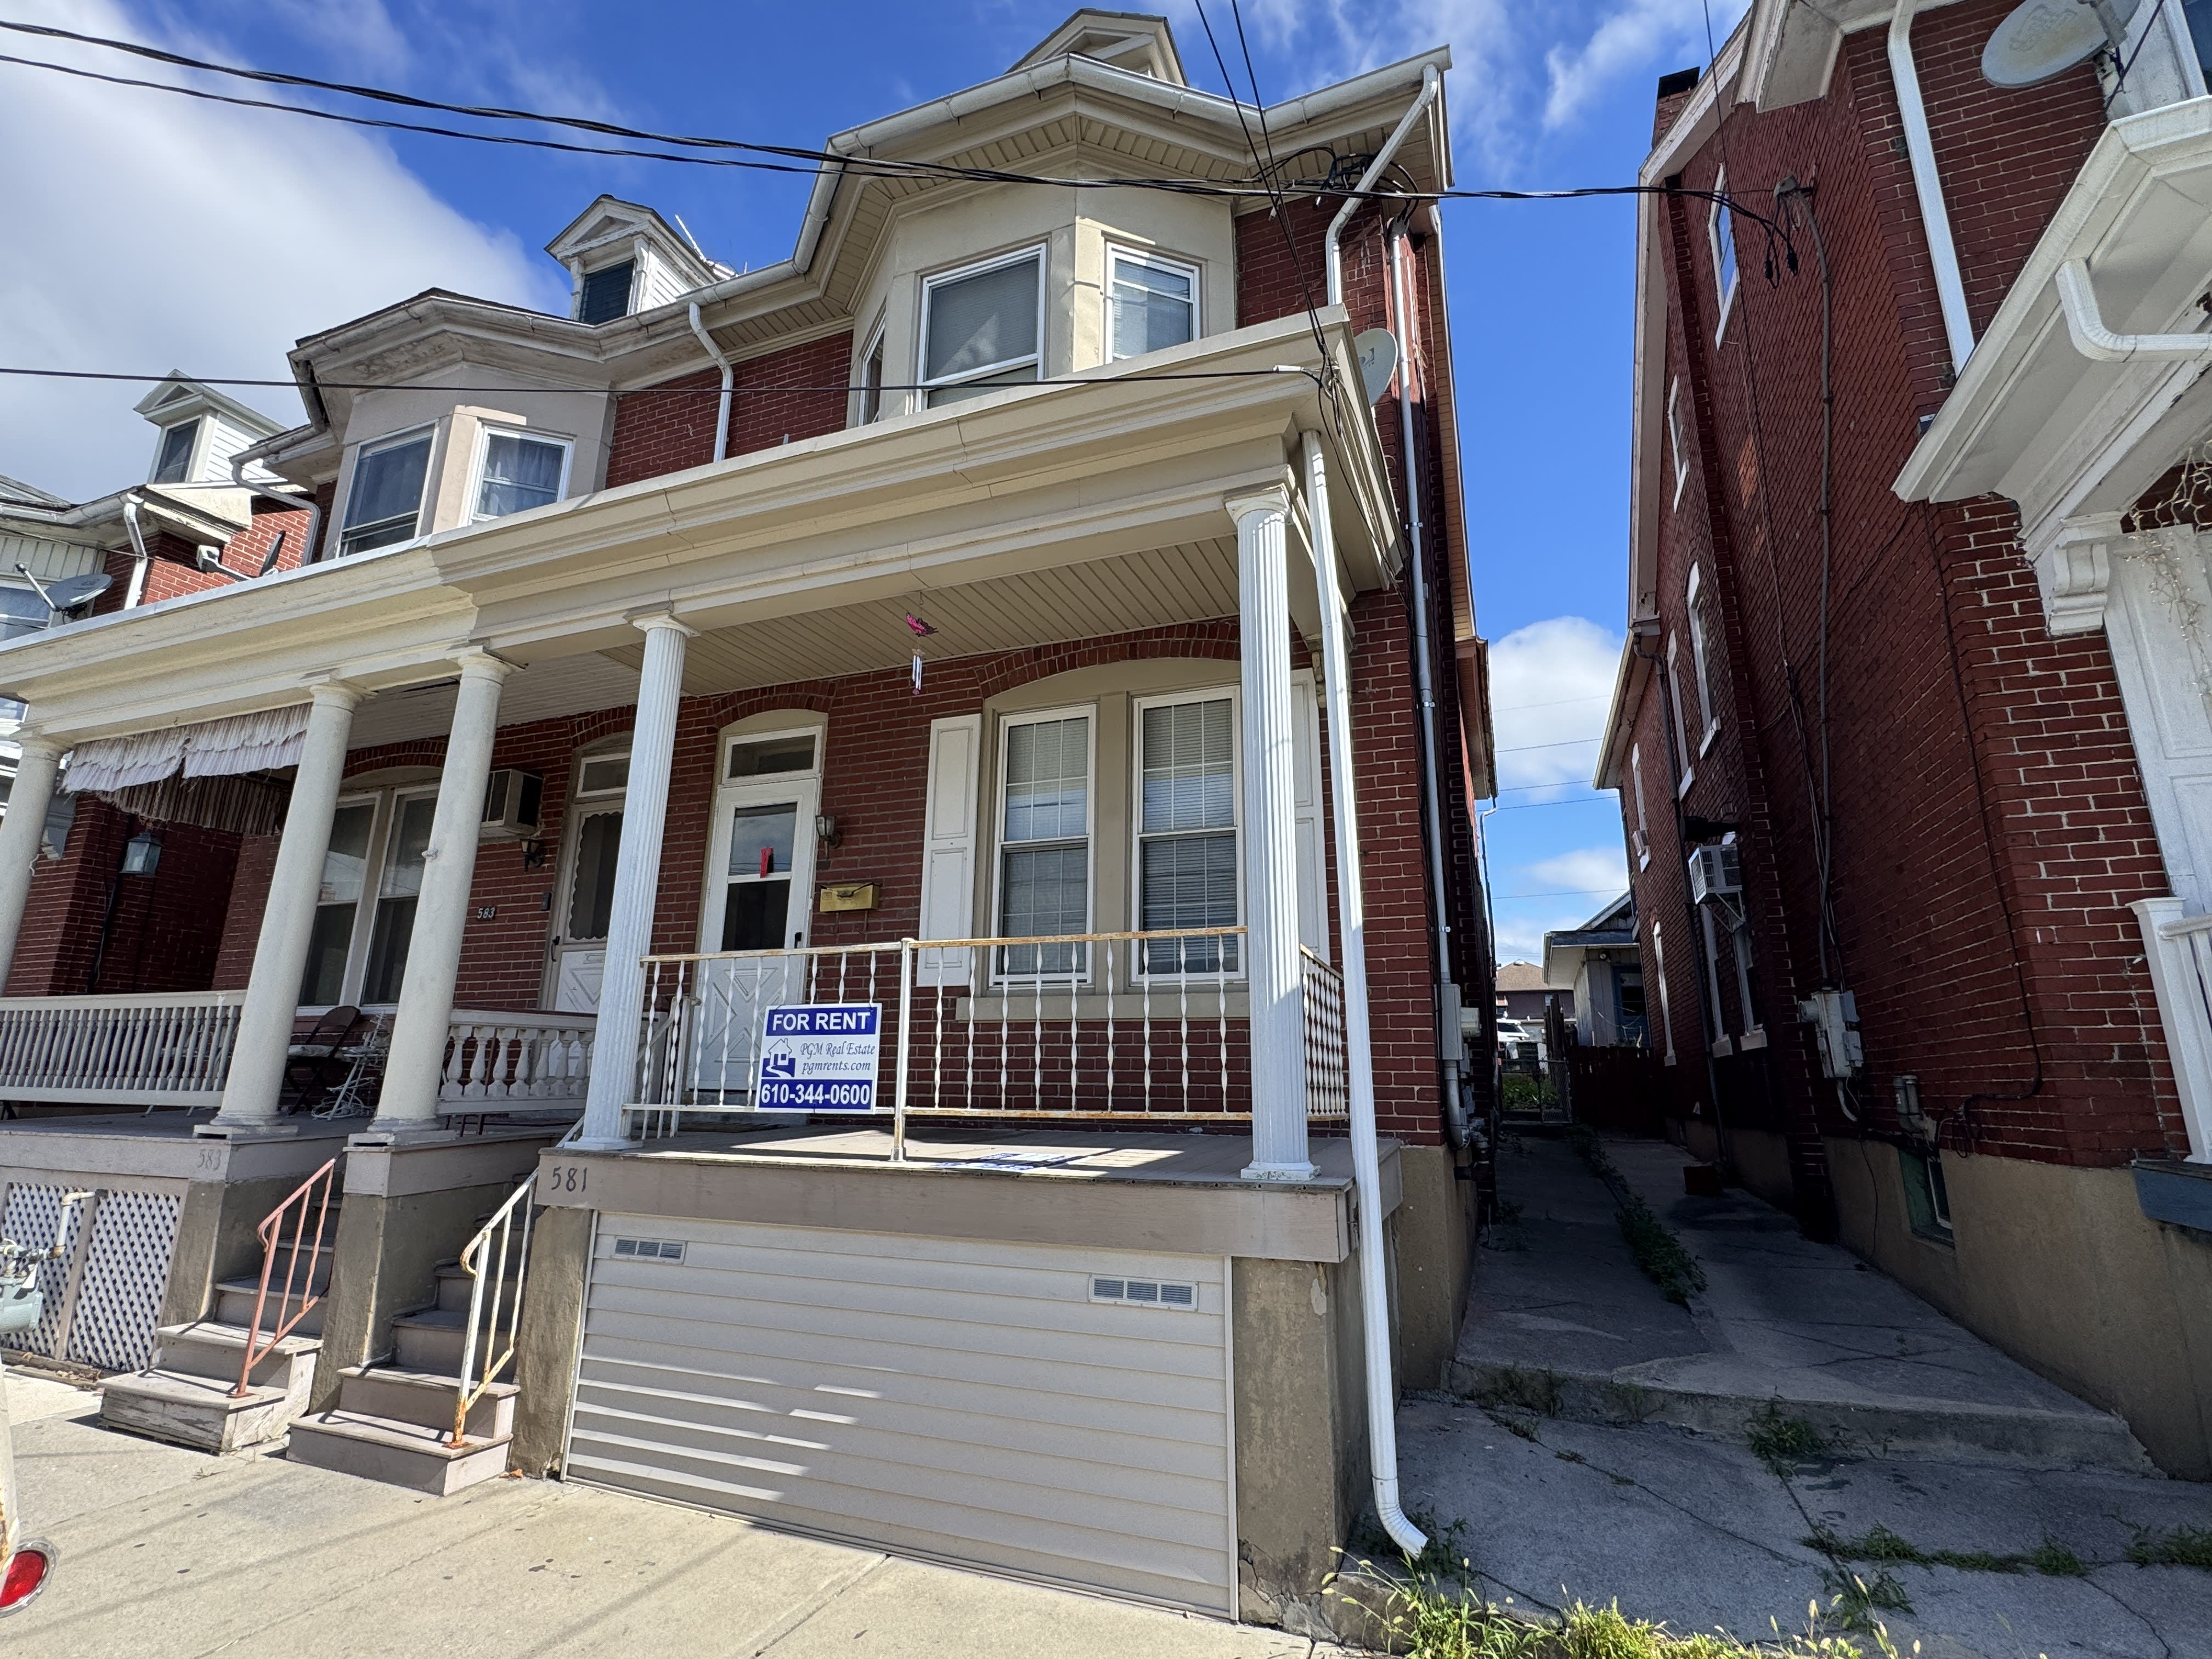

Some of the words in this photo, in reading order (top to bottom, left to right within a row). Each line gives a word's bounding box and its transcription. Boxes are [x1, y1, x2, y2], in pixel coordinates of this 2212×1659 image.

[477, 907, 495, 919] 583
[772, 1013, 810, 1031] FOR
[815, 1012, 871, 1030] RENT
[800, 1042, 823, 1059] PGM
[825, 1041, 847, 1057] Real
[847, 1042, 876, 1056] Estate
[801, 1060, 871, 1075] pgmrents.com
[761, 1083, 870, 1105] 610-344-0600
[551, 1166, 588, 1192] 581
